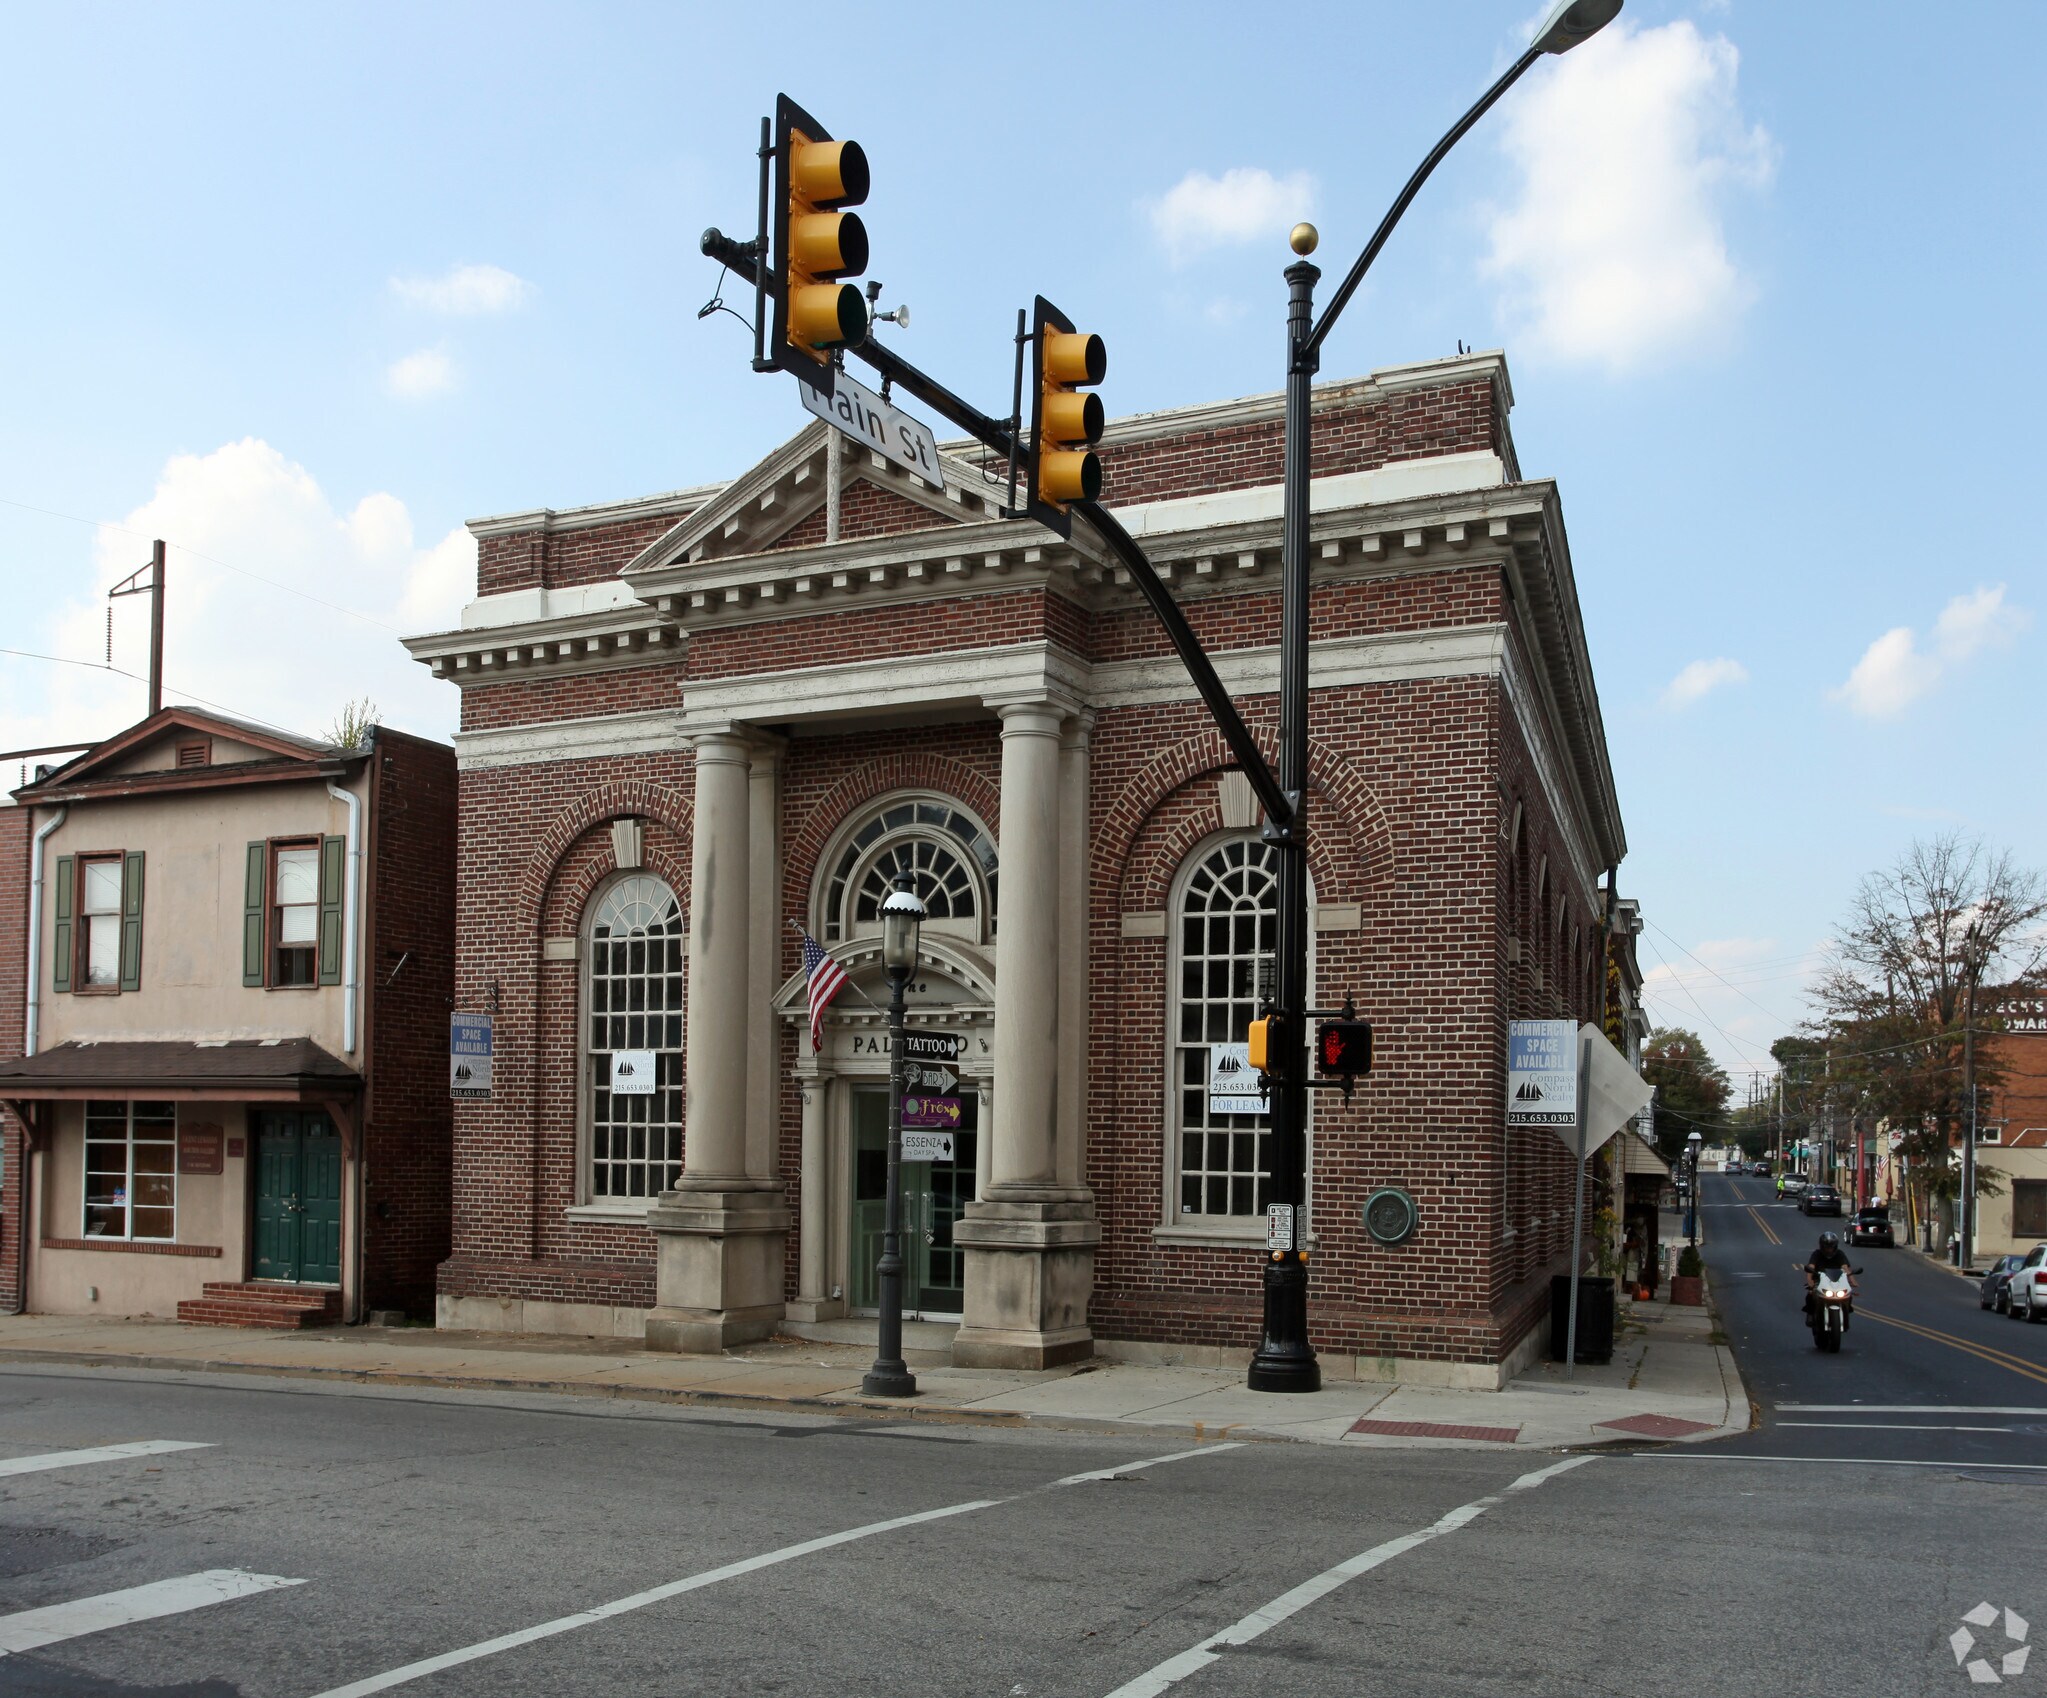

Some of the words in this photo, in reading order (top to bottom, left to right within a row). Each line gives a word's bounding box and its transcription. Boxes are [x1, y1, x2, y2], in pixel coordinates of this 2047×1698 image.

[899, 425, 931, 472] St
[452, 1014, 491, 1029] COMMERCIAL
[461, 1029, 482, 1041] SPACE
[1511, 1022, 1575, 1037] COMMERCIAL
[454, 1041, 488, 1054] AVAILABLE
[907, 1037, 947, 1053] TATTOO
[1526, 1038, 1558, 1052] SPACE
[463, 1056, 491, 1068] Compass
[1516, 1055, 1569, 1069] AVAILABLE
[472, 1064, 491, 1073] North
[472, 1073, 491, 1082] Realty
[1529, 1072, 1575, 1085] Compass
[614, 1084, 654, 1092] 215.653.0303
[1213, 1083, 1261, 1091] 215.653.03
[1544, 1083, 1574, 1092] North
[452, 1089, 491, 1098] 215.653.0303
[1544, 1092, 1574, 1104] Realty
[1212, 1100, 1233, 1111] FOR
[1510, 1113, 1574, 1123] 215.653.0303
[906, 1136, 943, 1148] ESSENZA
